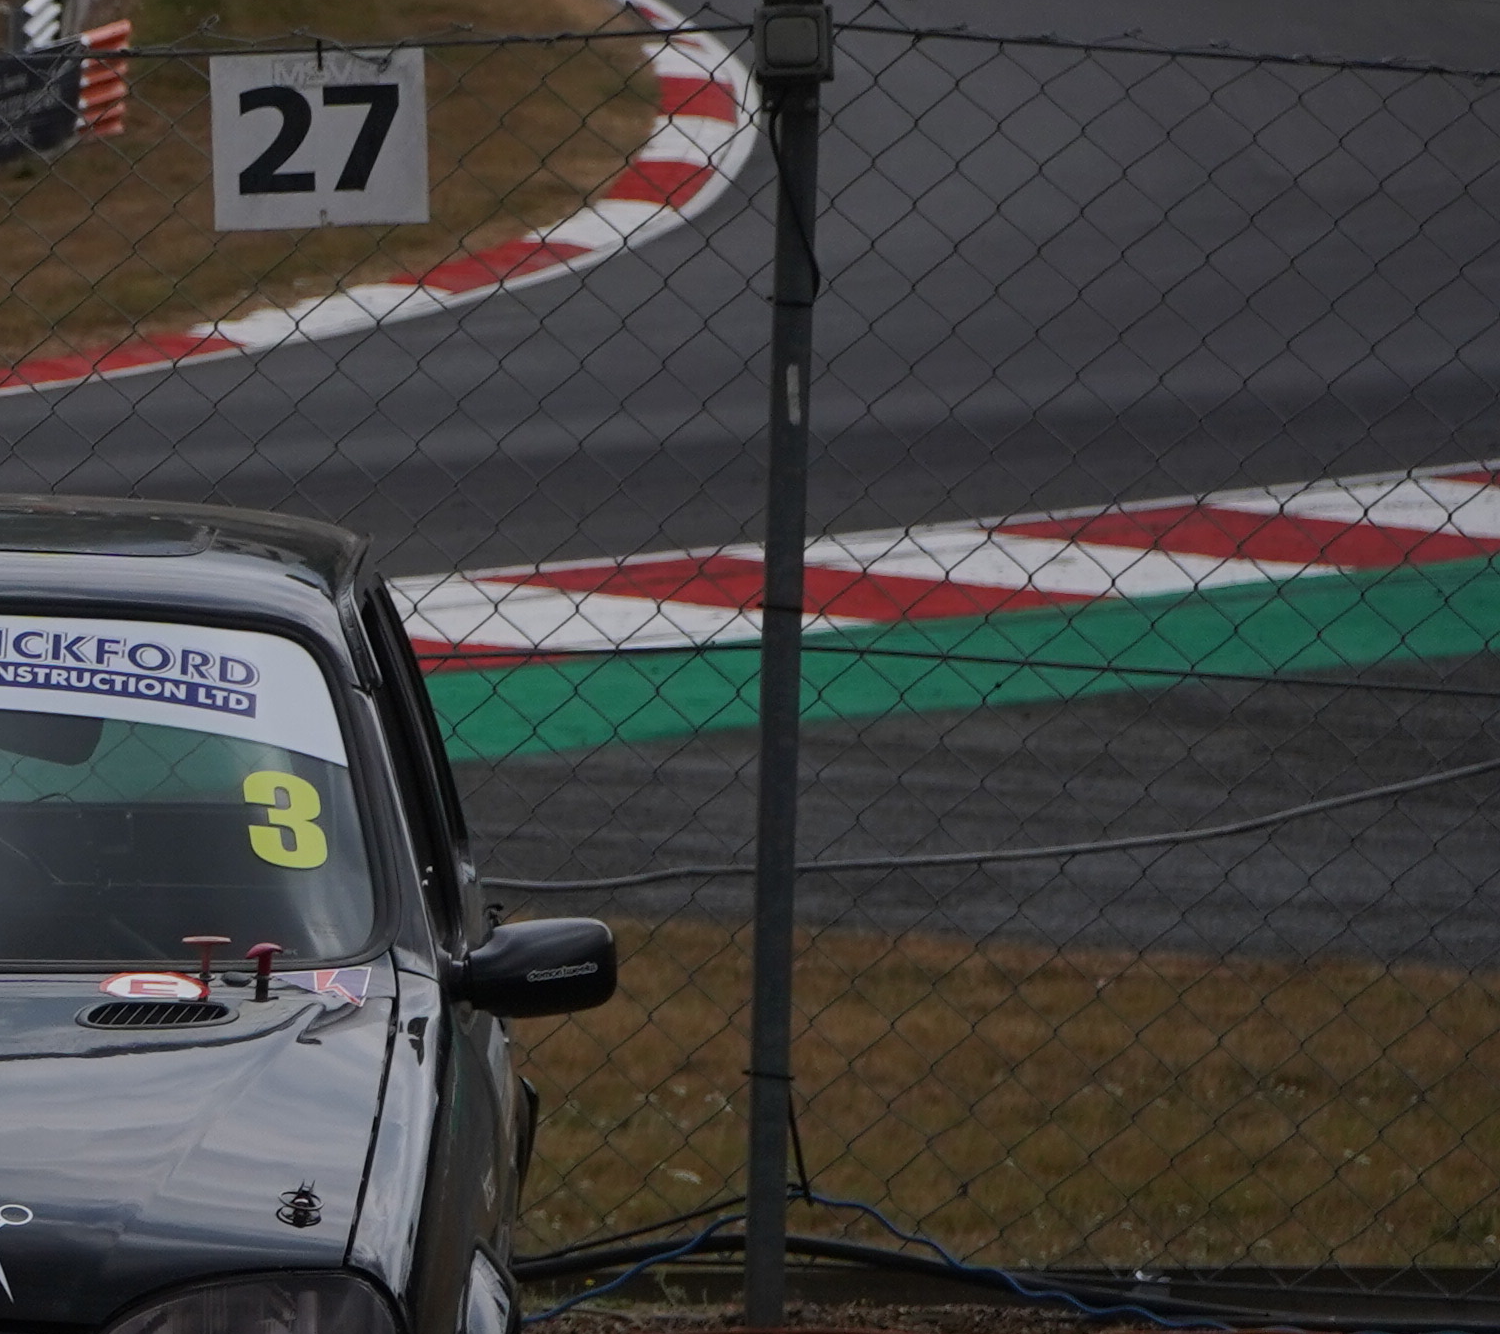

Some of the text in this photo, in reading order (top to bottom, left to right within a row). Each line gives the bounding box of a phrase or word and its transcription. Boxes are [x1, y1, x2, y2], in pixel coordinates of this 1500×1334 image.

[239, 83, 399, 195] 27
[197, 685, 251, 711] LTD
[243, 770, 328, 869] 3
